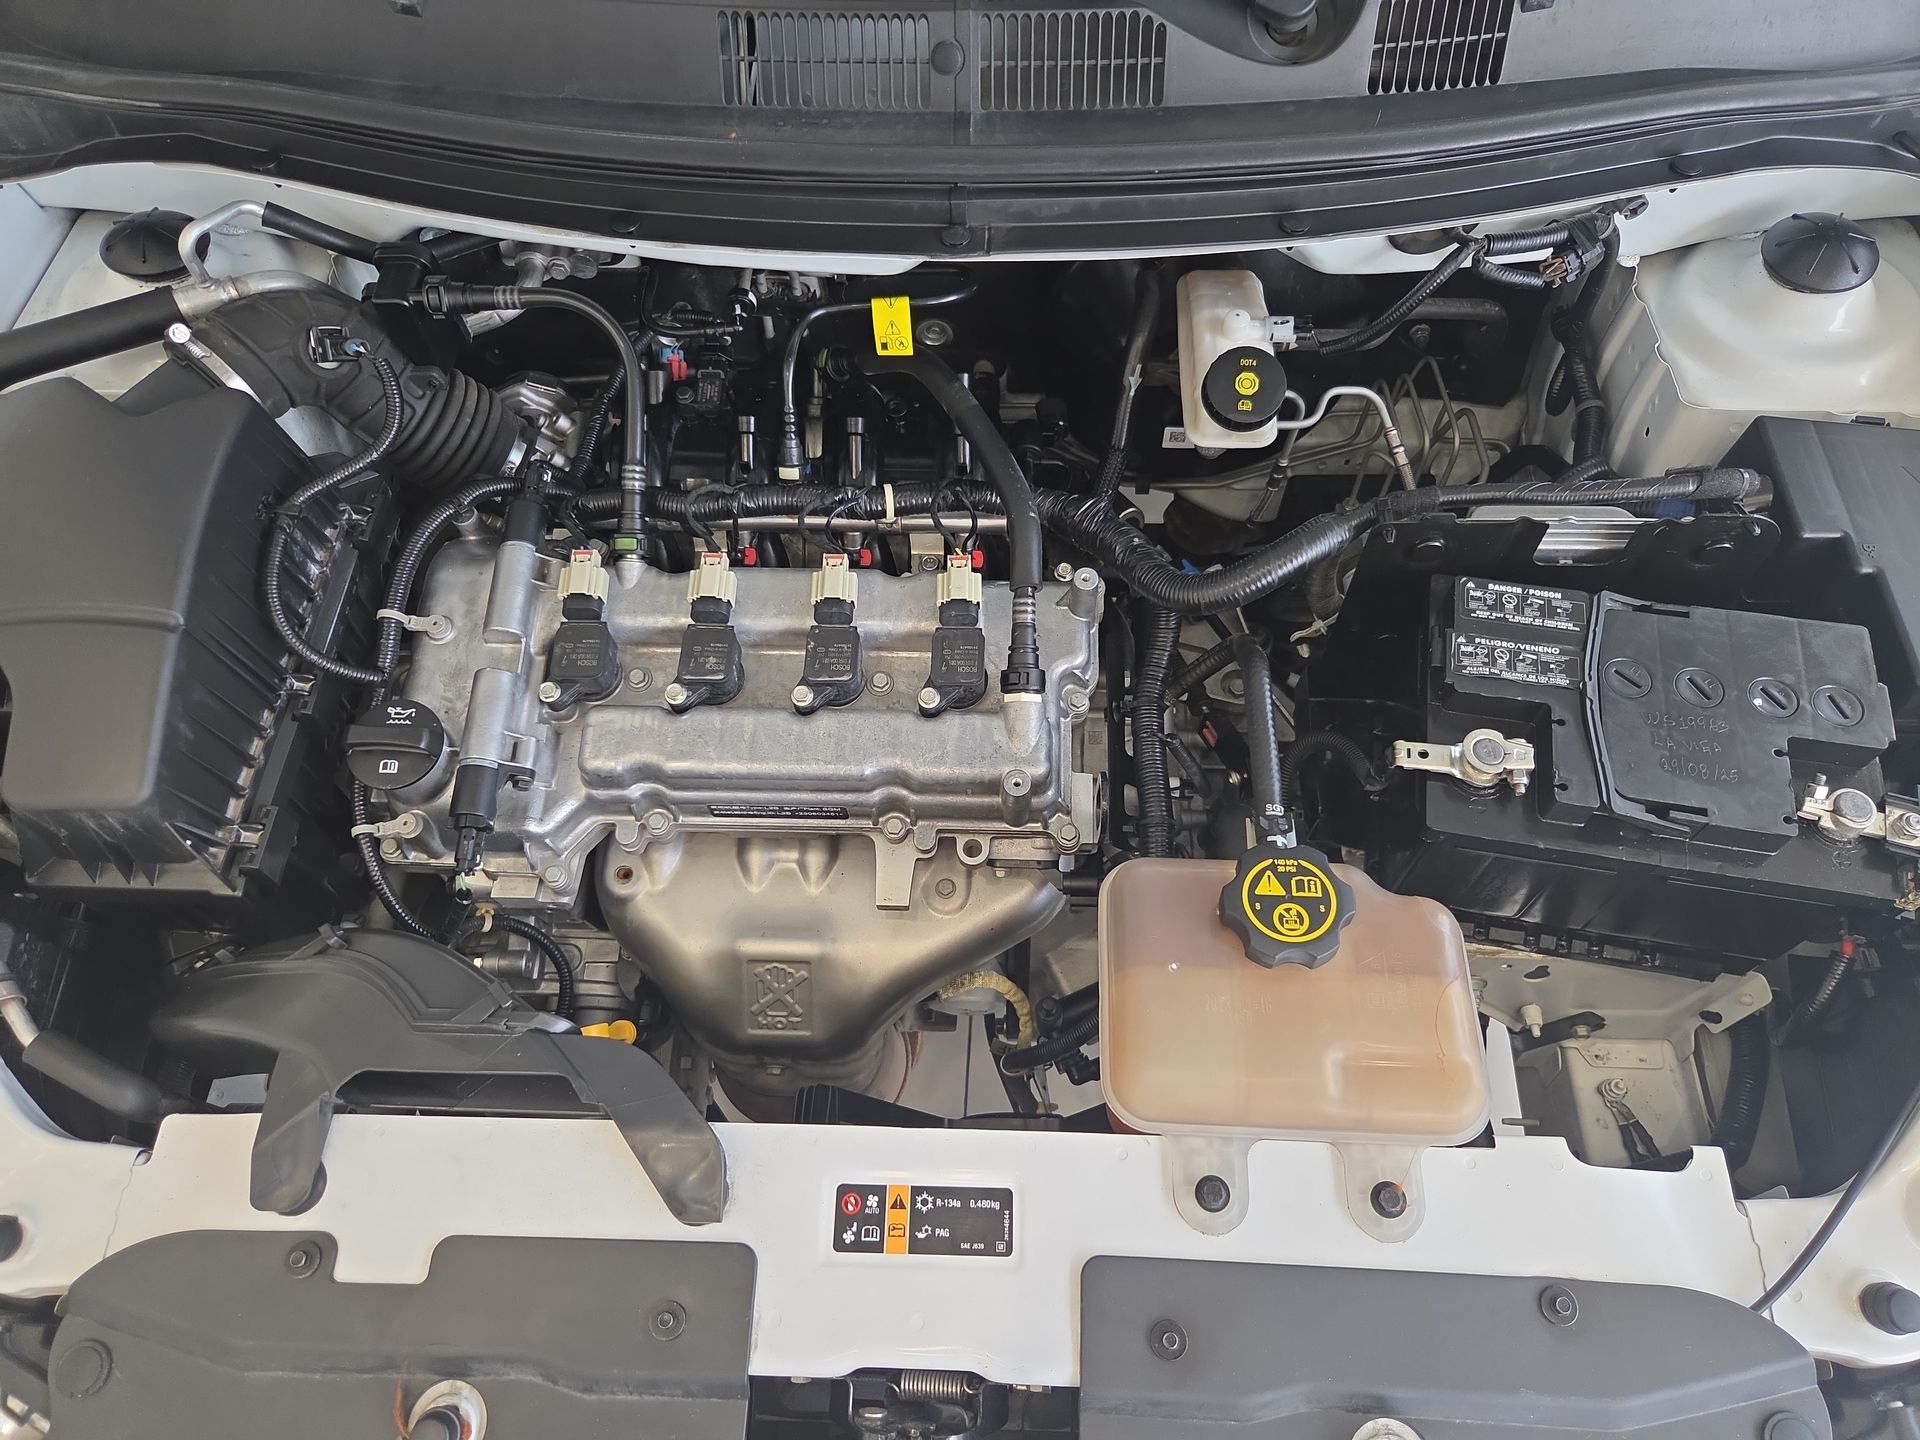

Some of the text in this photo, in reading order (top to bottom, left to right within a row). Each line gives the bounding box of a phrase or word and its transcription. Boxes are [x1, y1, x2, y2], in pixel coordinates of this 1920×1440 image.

[1488, 584, 1522, 594] DANGER
[1654, 732, 1676, 750] LA
[1660, 756, 1739, 783] 29/08/25
[1277, 865, 1286, 873] 20
[1255, 902, 1261, 910] S
[1319, 905, 1326, 913] S
[758, 1016, 802, 1030] HOT
[936, 1198, 1000, 1210] R-134a 0.480kg
[864, 1207, 880, 1215] AUTO
[935, 1228, 950, 1237] PAG
[972, 1243, 985, 1251] J639
